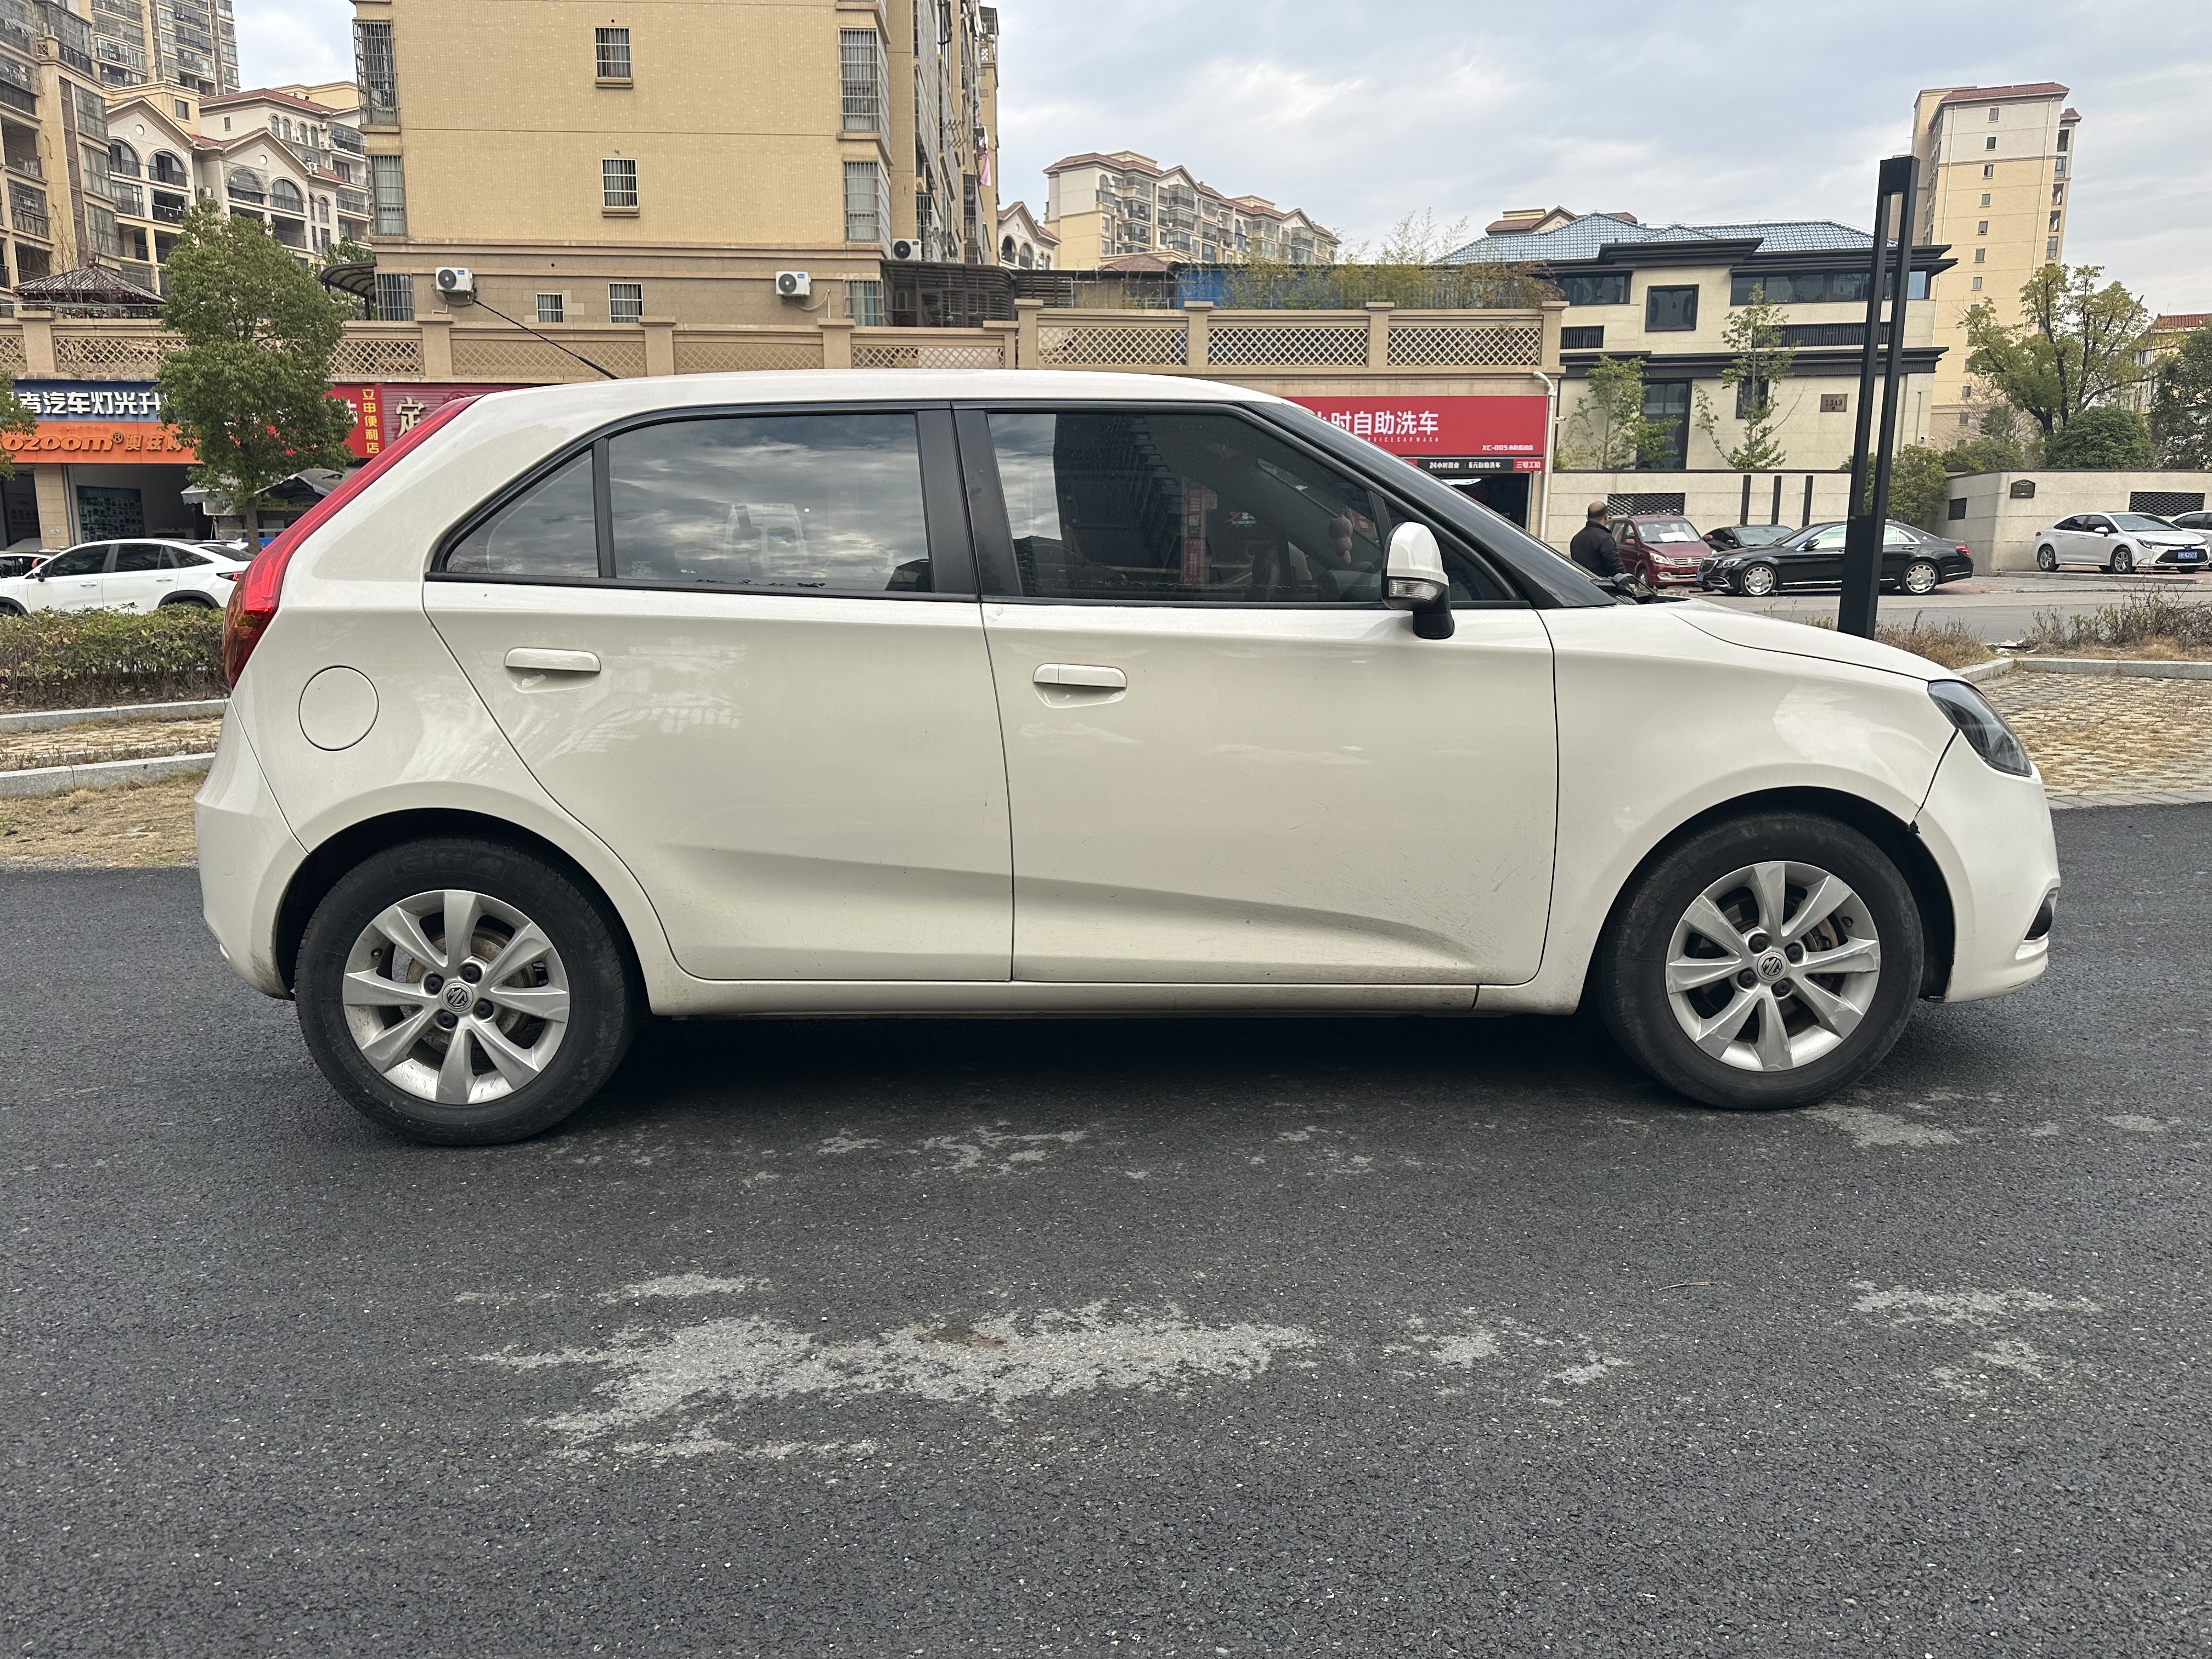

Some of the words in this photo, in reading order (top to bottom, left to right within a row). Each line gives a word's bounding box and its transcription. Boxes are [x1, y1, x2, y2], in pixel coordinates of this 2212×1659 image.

[7, 391, 168, 415] 者汽车灯光升
[362, 388, 380, 454] 立申便利店
[1762, 956, 1783, 977] MG
[447, 987, 468, 1007] MG
